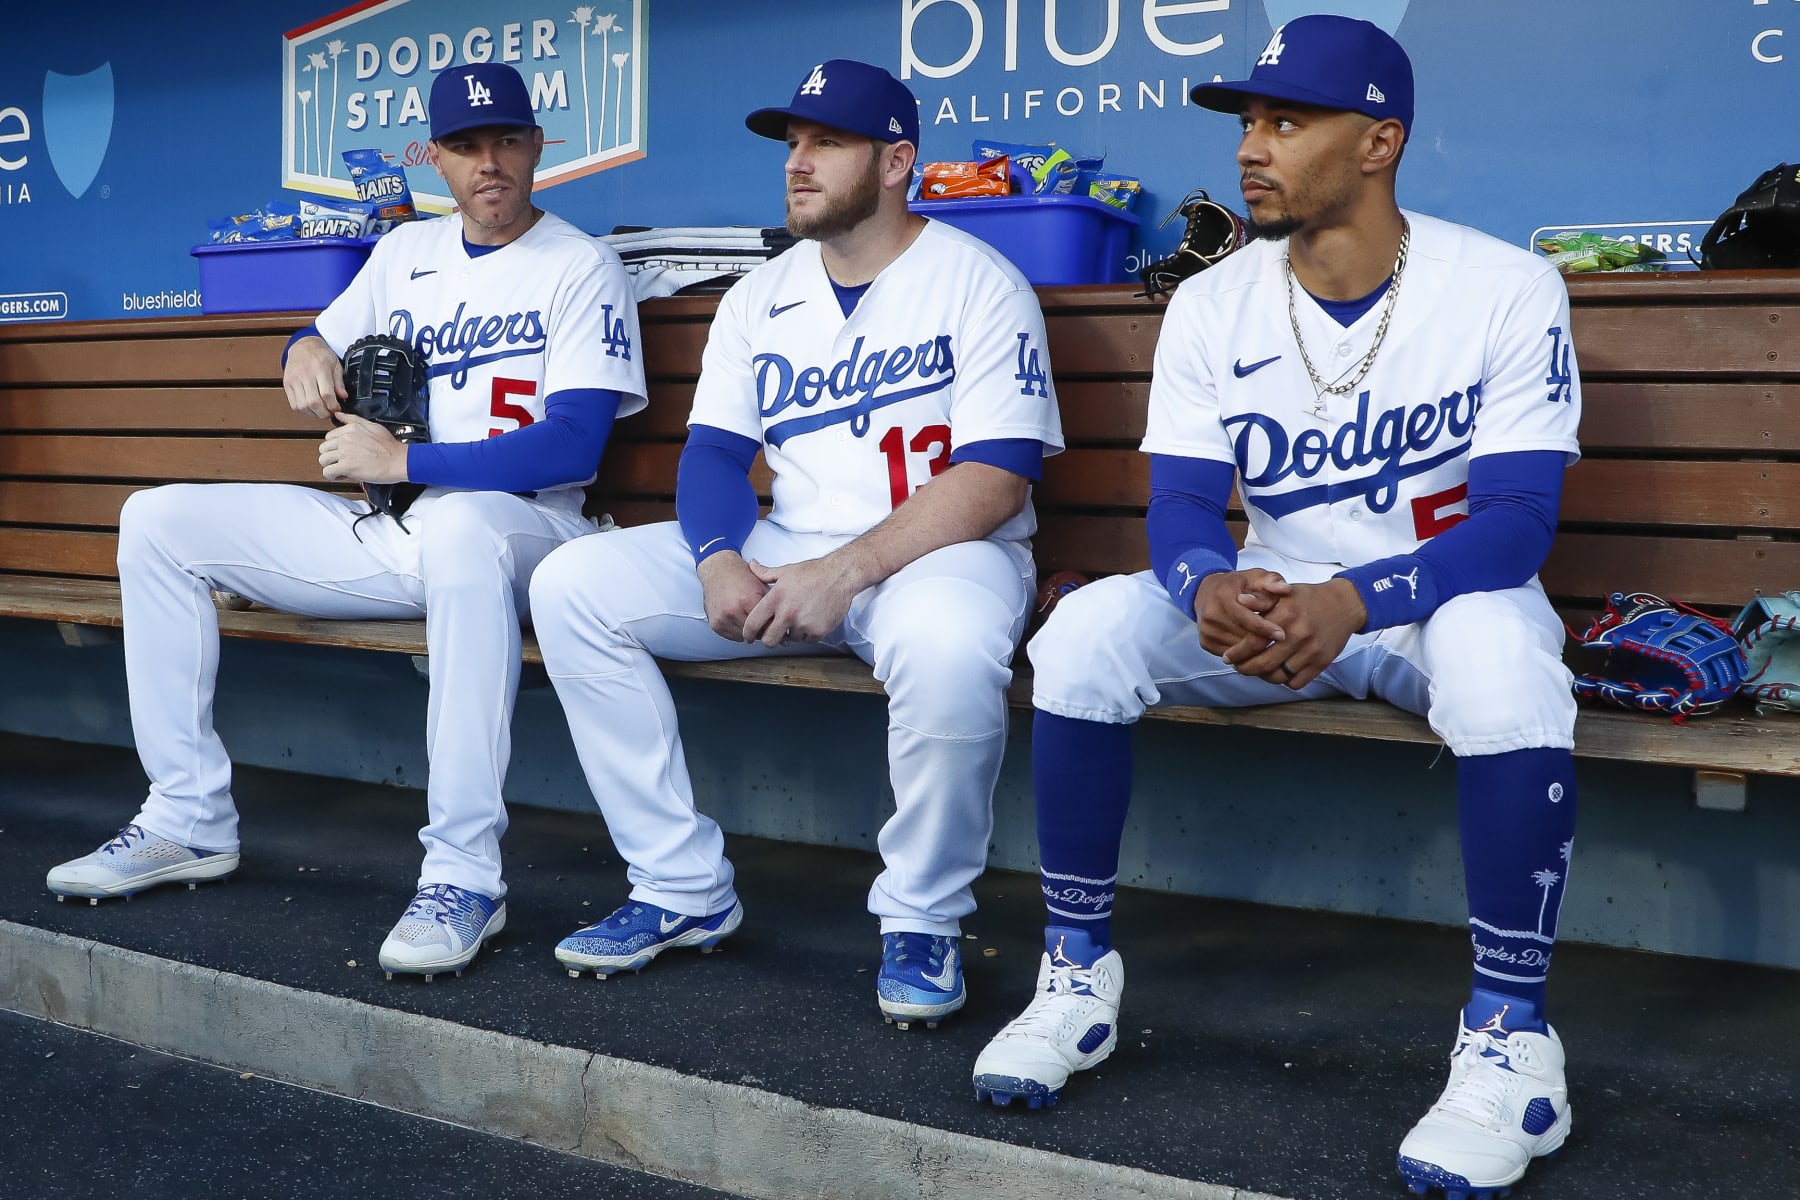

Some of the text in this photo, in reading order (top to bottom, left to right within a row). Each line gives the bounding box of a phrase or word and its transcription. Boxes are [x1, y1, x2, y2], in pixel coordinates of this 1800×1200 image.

[356, 19, 558, 81] DODGER
[464, 75, 493, 107] LA
[801, 64, 827, 95] LA
[917, 75, 1224, 126] ALIFORNI
[301, 219, 360, 239] GIANTS
[0, 299, 60, 314] GERS.COM
[601, 304, 631, 361] LA
[389, 302, 548, 390] Dodgers
[1014, 333, 1048, 398] LA
[489, 376, 536, 438] 5
